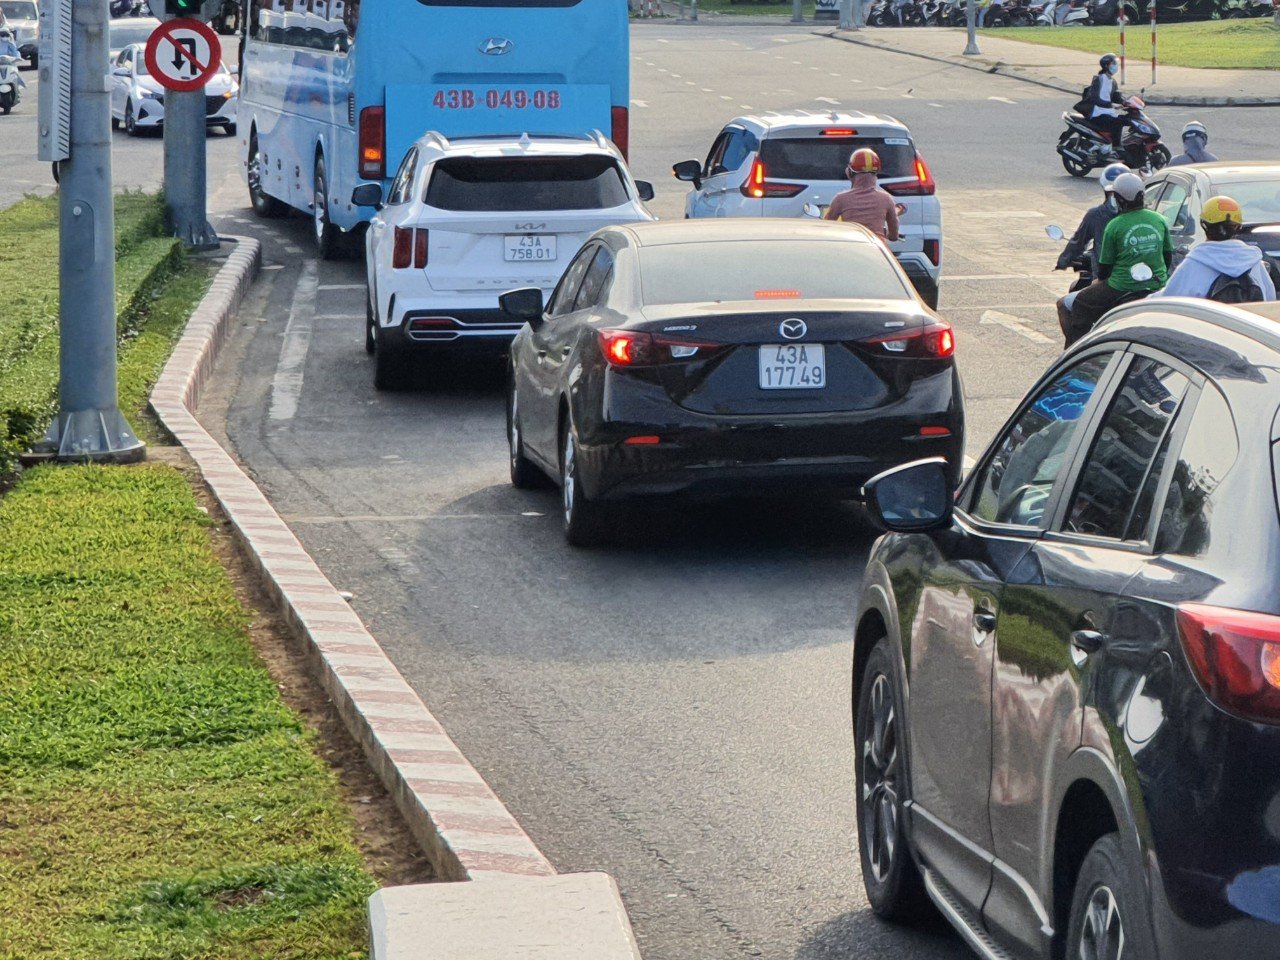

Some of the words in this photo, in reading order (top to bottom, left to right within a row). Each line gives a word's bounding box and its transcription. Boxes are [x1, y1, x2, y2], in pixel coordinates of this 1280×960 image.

[519, 236, 541, 247] 43A
[511, 248, 550, 259] 758.01
[776, 345, 808, 363] 43A
[765, 367, 822, 386] 177.49
